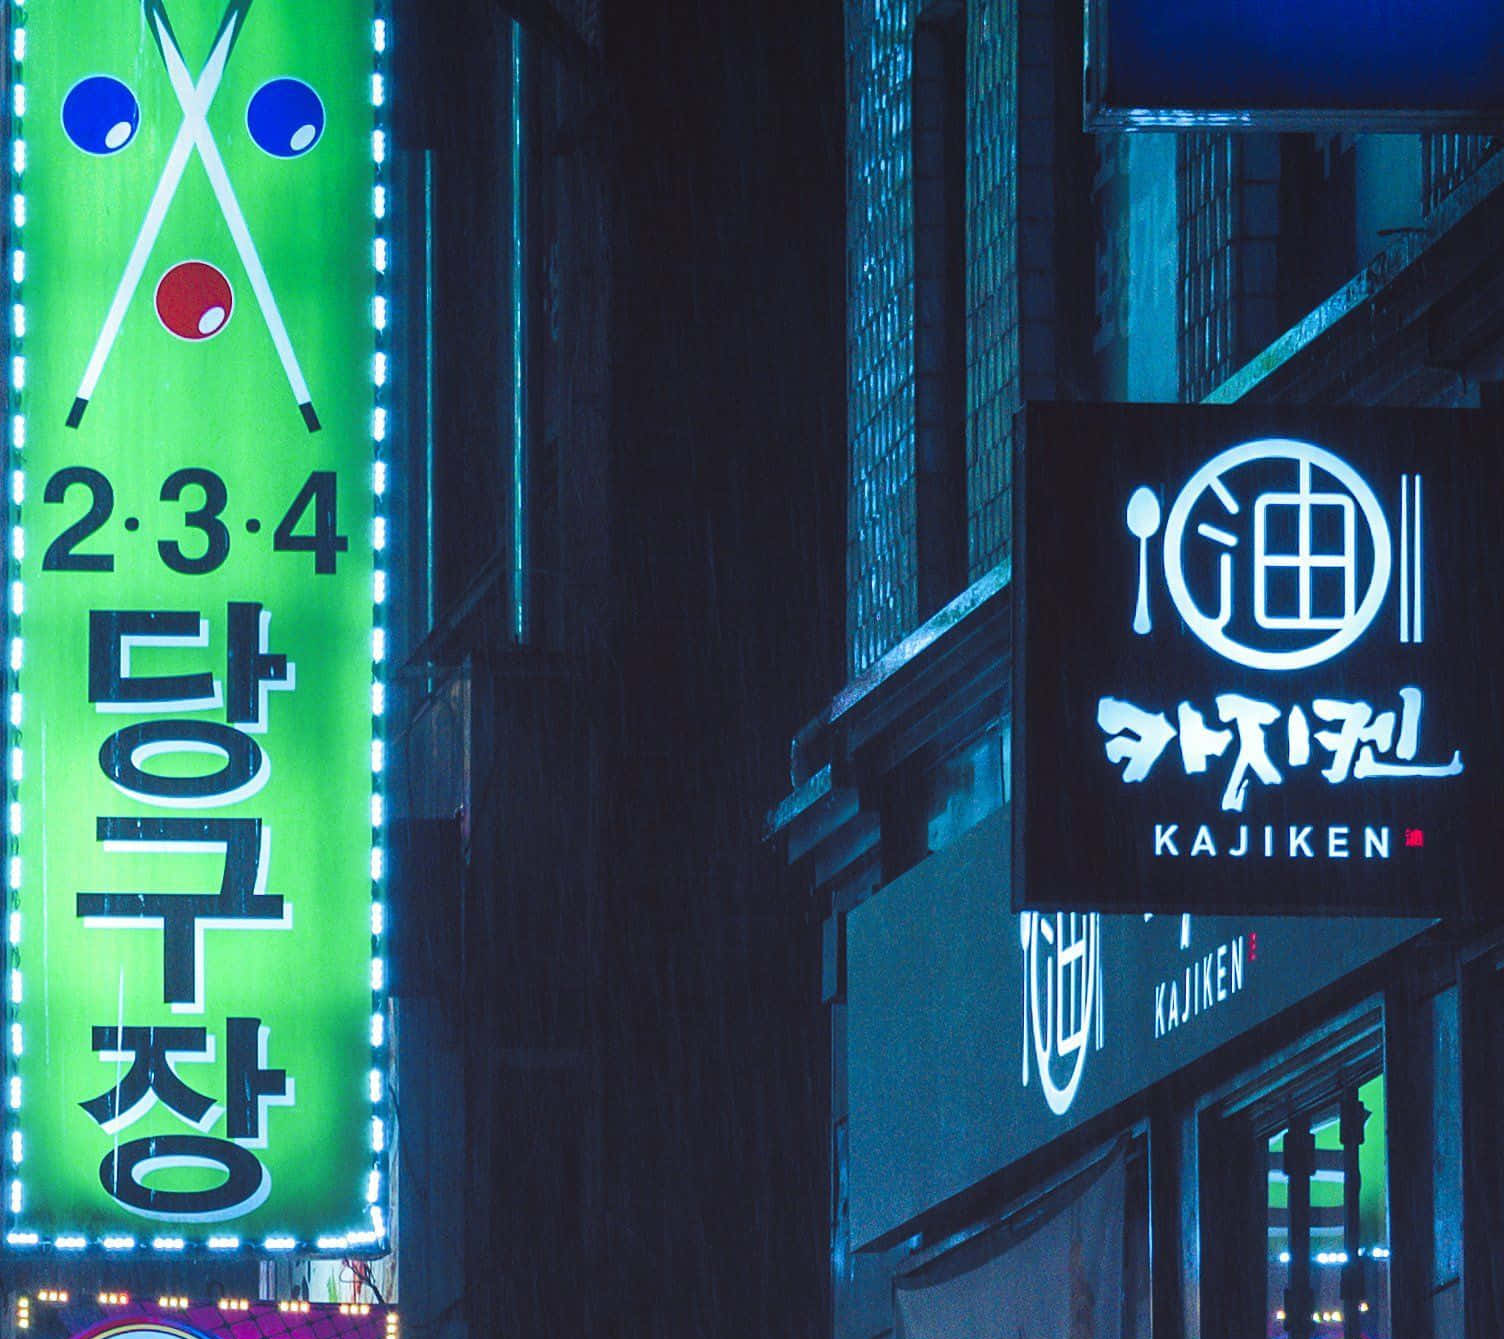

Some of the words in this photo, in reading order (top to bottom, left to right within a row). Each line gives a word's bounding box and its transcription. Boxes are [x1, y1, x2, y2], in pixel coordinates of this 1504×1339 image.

[1097, 687, 1464, 811] 카지켄
[1154, 824, 1391, 859] KAJIKEN
[77, 602, 293, 1218] 당구장
[1154, 933, 1245, 1040] KAJIKEN
